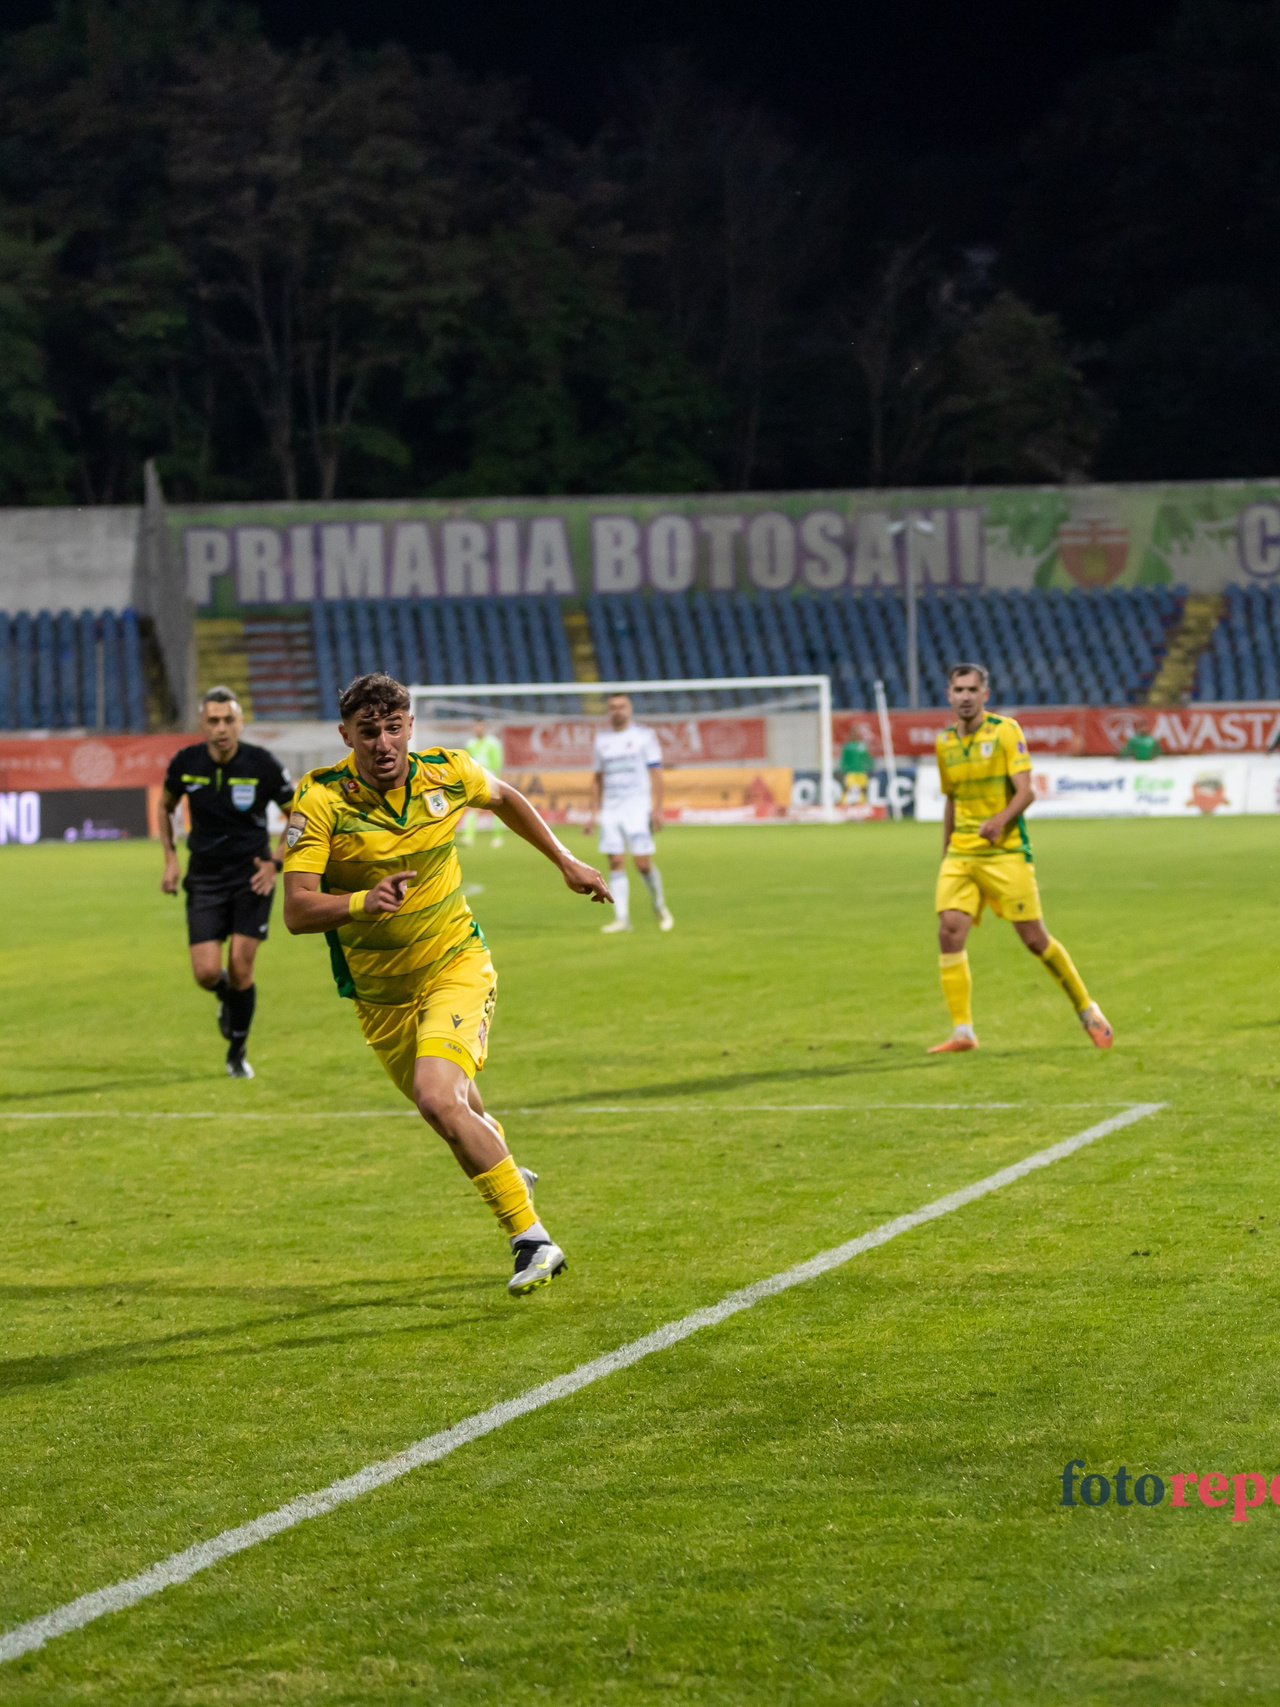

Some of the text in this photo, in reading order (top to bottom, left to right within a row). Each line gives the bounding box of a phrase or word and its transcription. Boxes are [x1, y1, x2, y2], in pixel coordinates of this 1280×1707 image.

[184, 507, 985, 604] PRIMARIA BOTOSANI
[1056, 774, 1176, 792] Smart Eco
